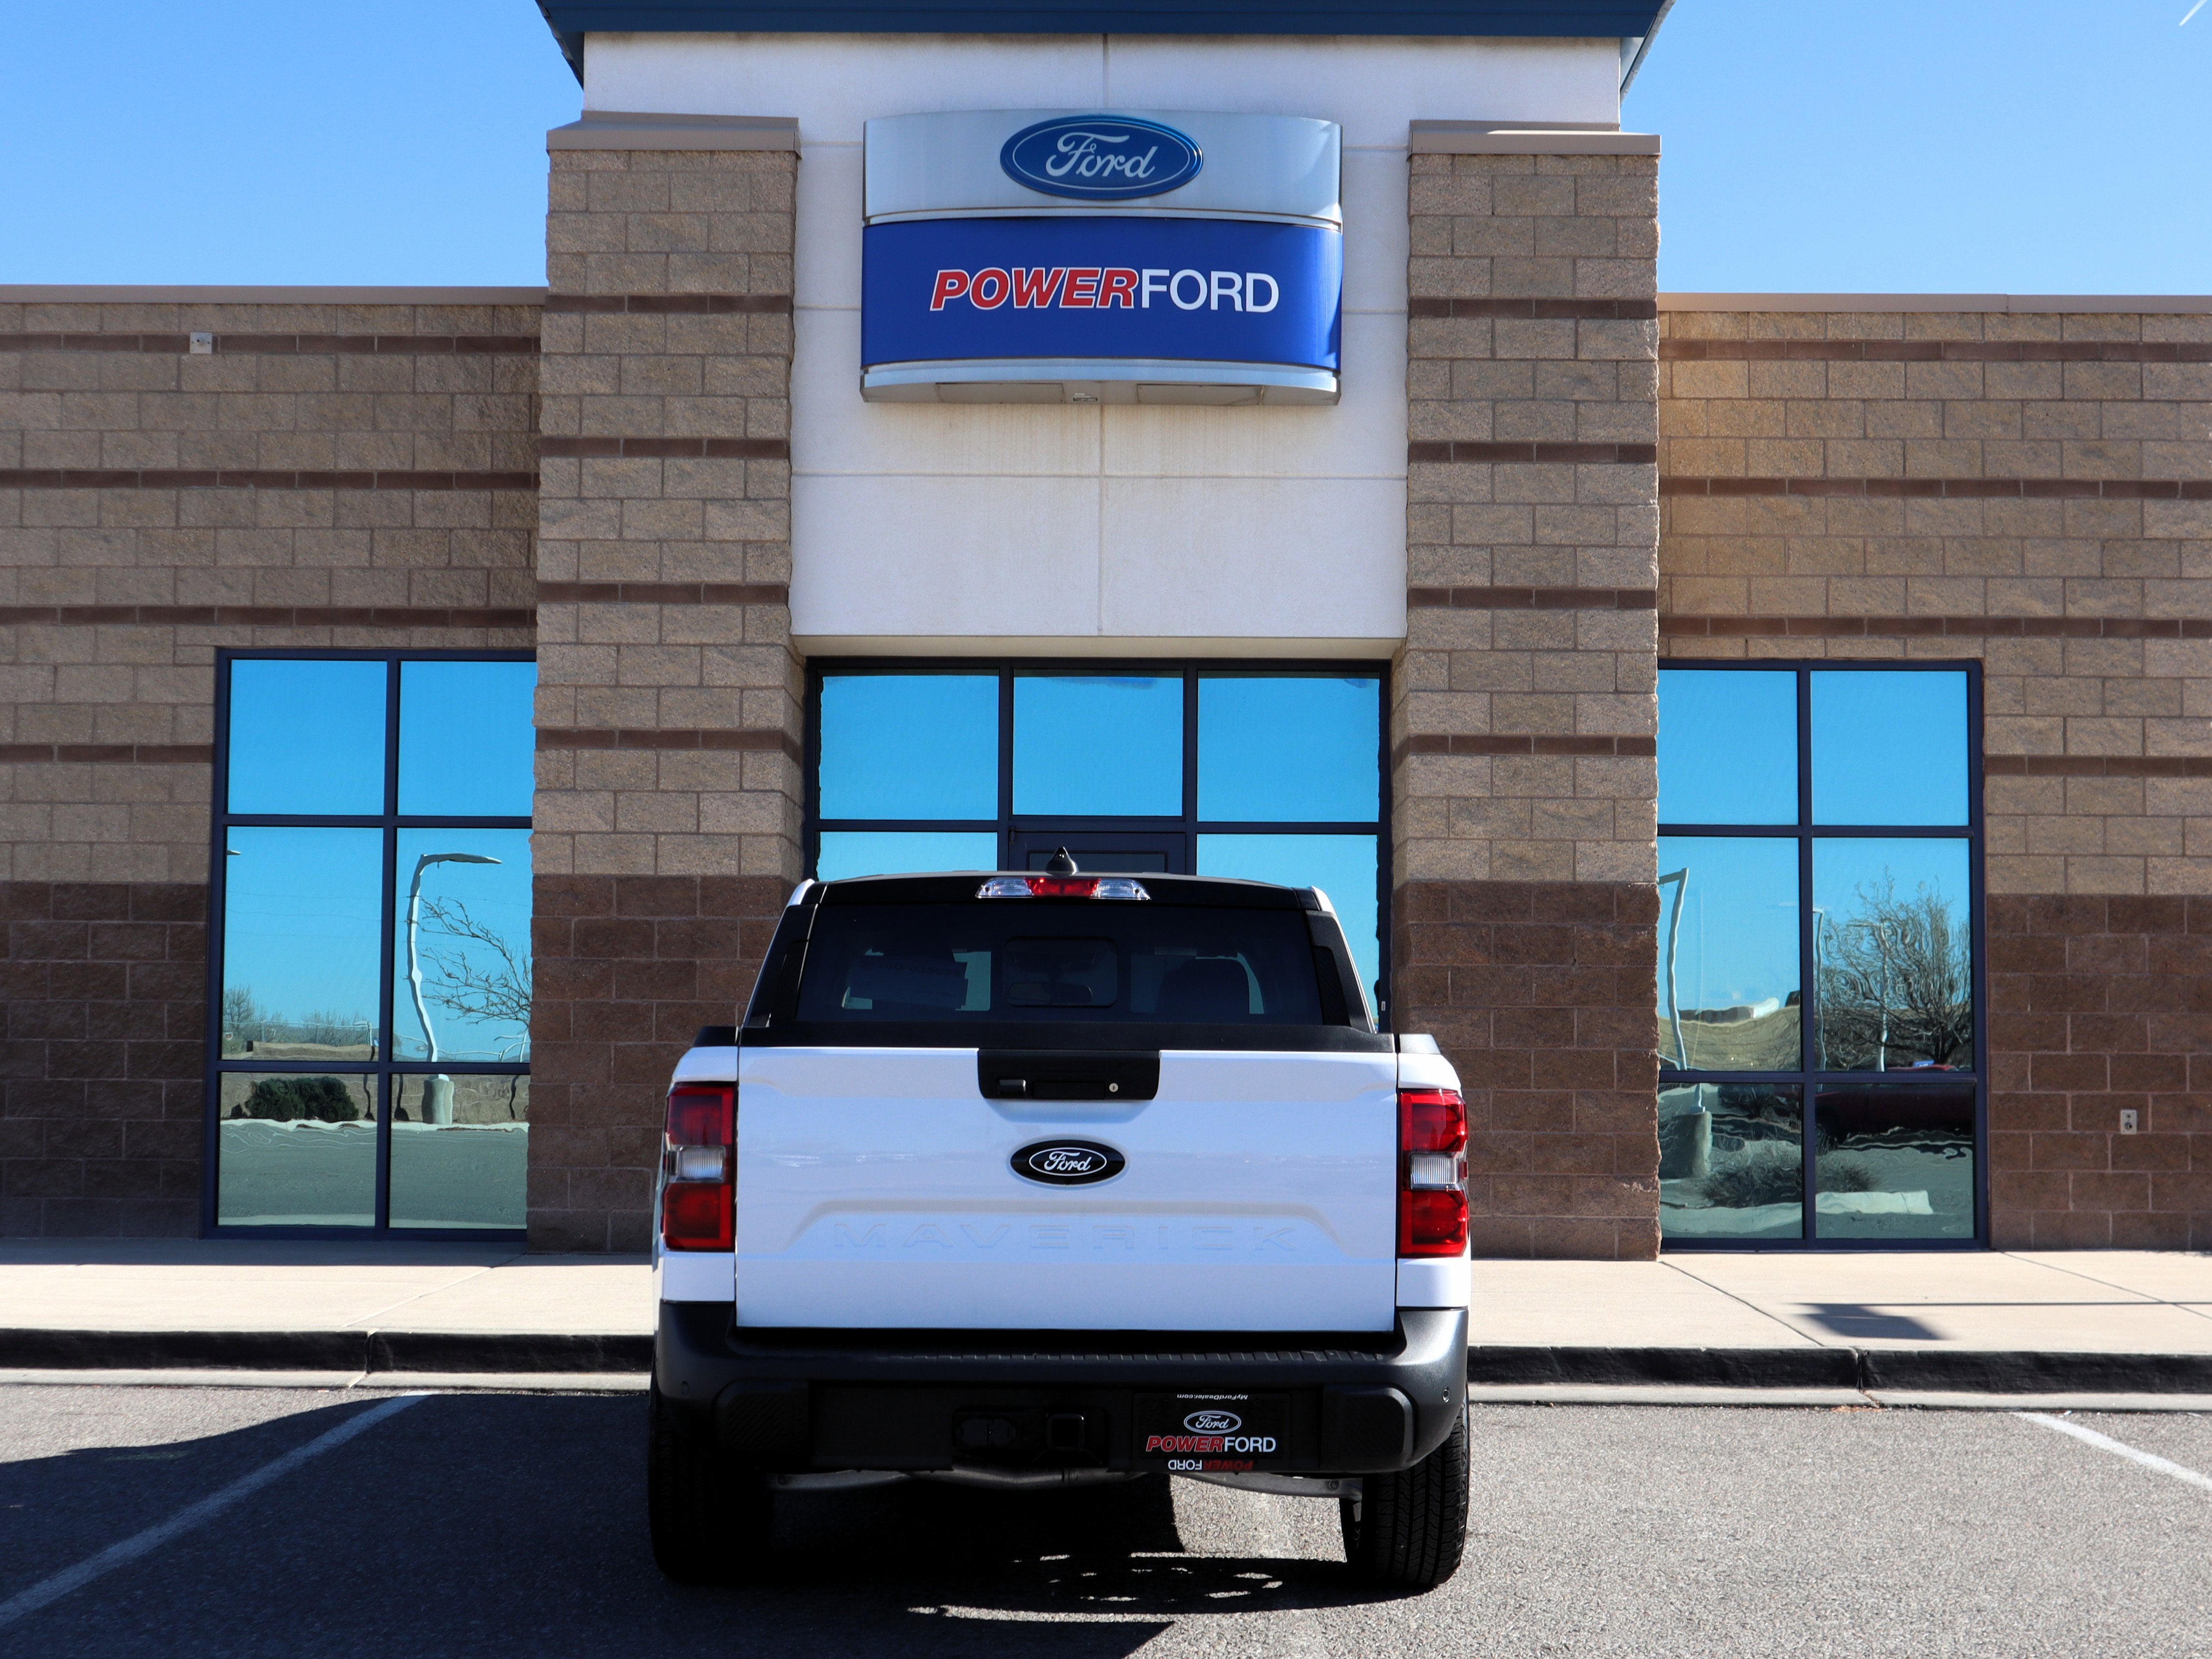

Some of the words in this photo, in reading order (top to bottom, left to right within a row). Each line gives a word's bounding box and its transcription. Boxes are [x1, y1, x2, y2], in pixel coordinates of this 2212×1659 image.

[1044, 131, 1156, 179] Ford
[929, 266, 1279, 313] POWERFORD
[1044, 1150, 1091, 1171] Ford
[833, 1224, 1297, 1251] MAVERICK
[1195, 1415, 1230, 1429] Ford
[1146, 1435, 1276, 1452] POWERFORD
